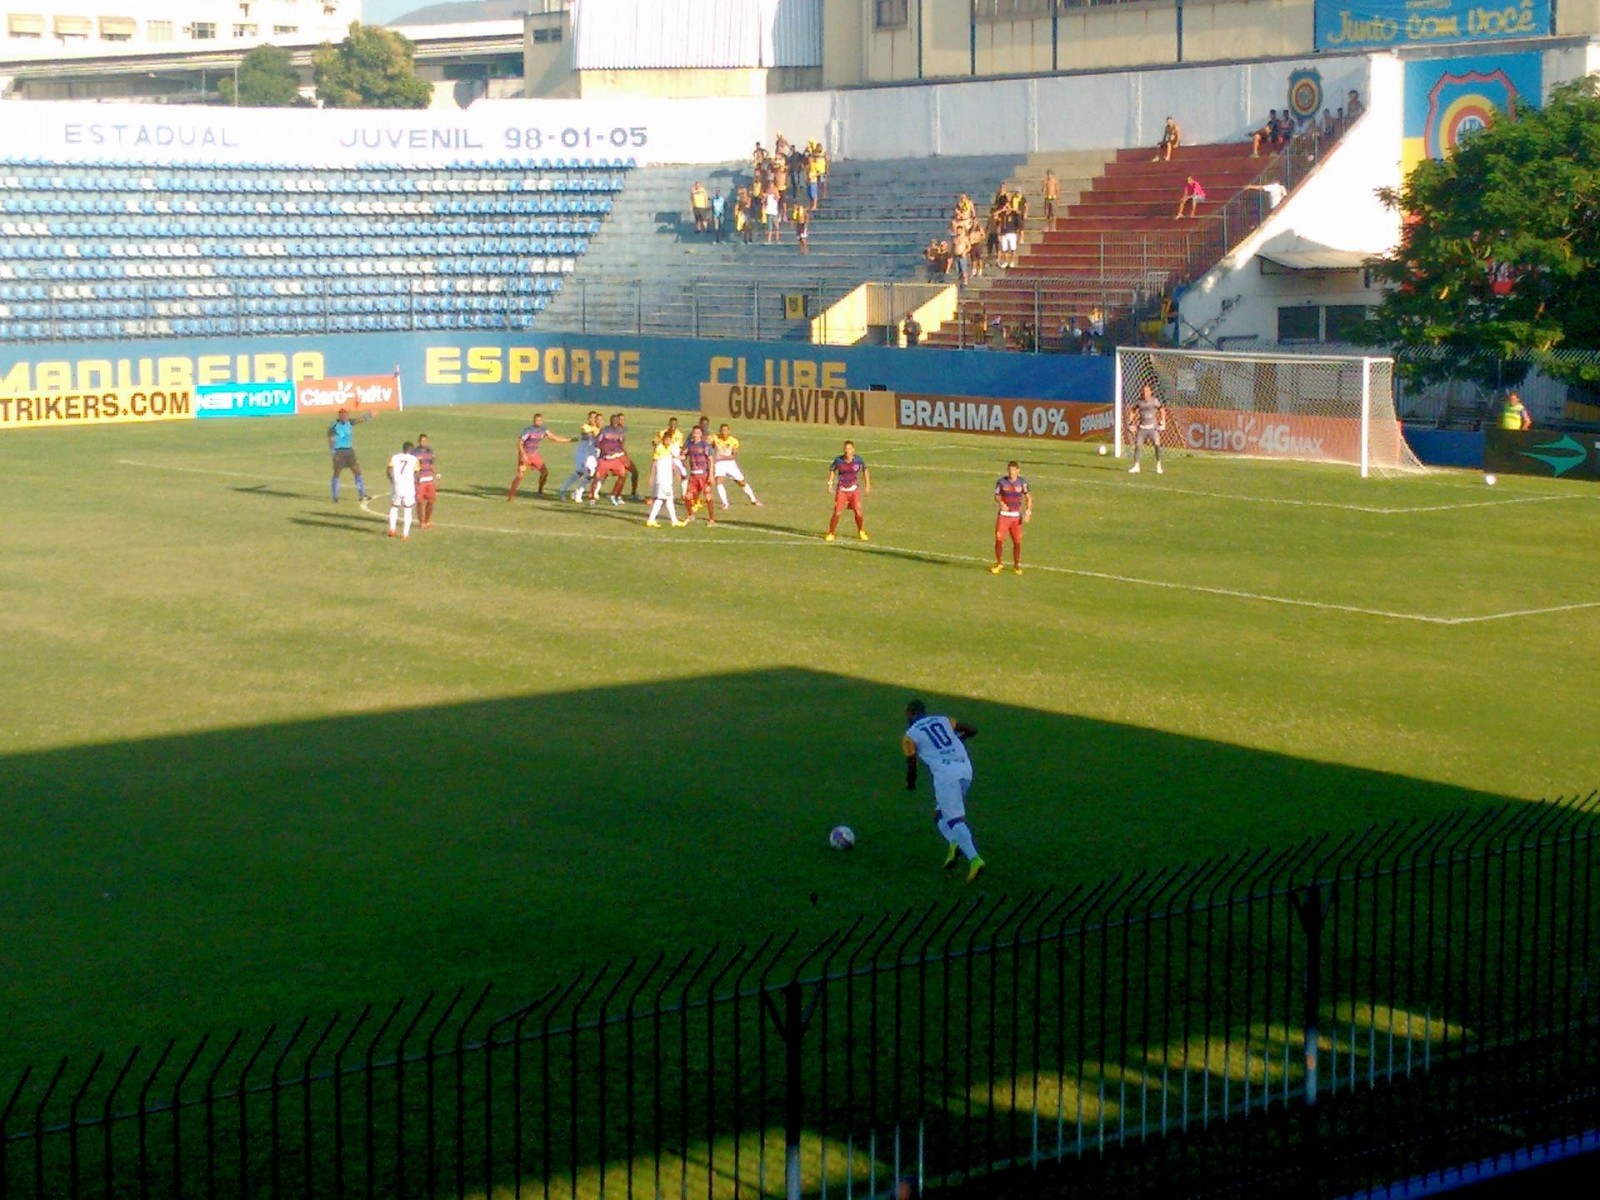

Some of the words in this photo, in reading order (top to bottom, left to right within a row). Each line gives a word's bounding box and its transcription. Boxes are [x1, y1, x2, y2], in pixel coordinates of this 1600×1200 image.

[64, 124, 240, 147] ESTADUAL
[340, 128, 482, 150] JUVENIL
[505, 127, 648, 150] 98-01-05
[425, 347, 640, 389] ESPORTE
[710, 356, 847, 388] CLUBE
[248, 390, 291, 407] HDTV
[301, 387, 350, 406] Claro
[356, 385, 392, 404] hdtv
[728, 386, 865, 426] GUARAVITON
[900, 399, 1006, 432] BRAHMA
[1187, 421, 1246, 450] Claro
[400, 460, 407, 475] 7
[920, 722, 952, 749] 10
